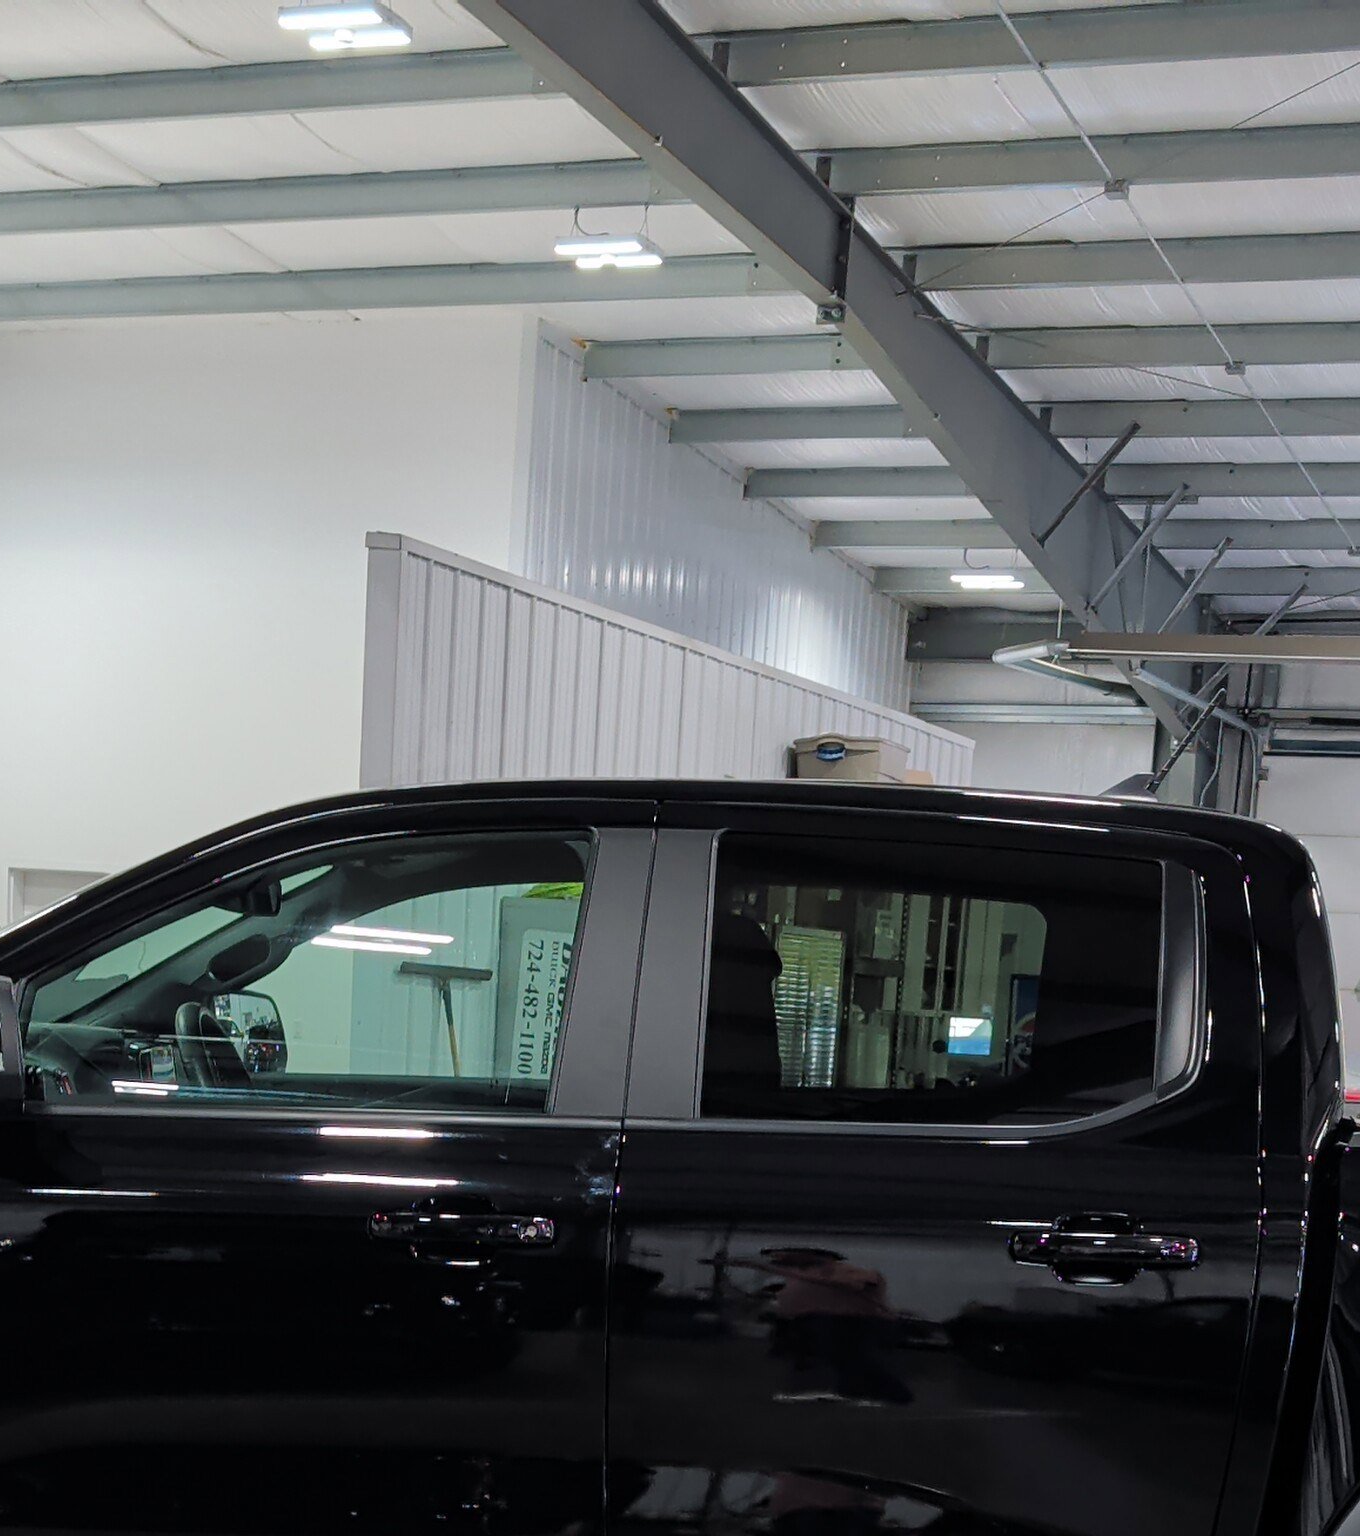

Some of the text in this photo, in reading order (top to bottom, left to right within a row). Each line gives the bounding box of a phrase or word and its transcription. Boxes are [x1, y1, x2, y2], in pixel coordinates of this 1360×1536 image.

[517, 939, 545, 1075] 724-482-1100
[545, 992, 555, 1027] GMC
[540, 1031, 551, 1075] mazda
